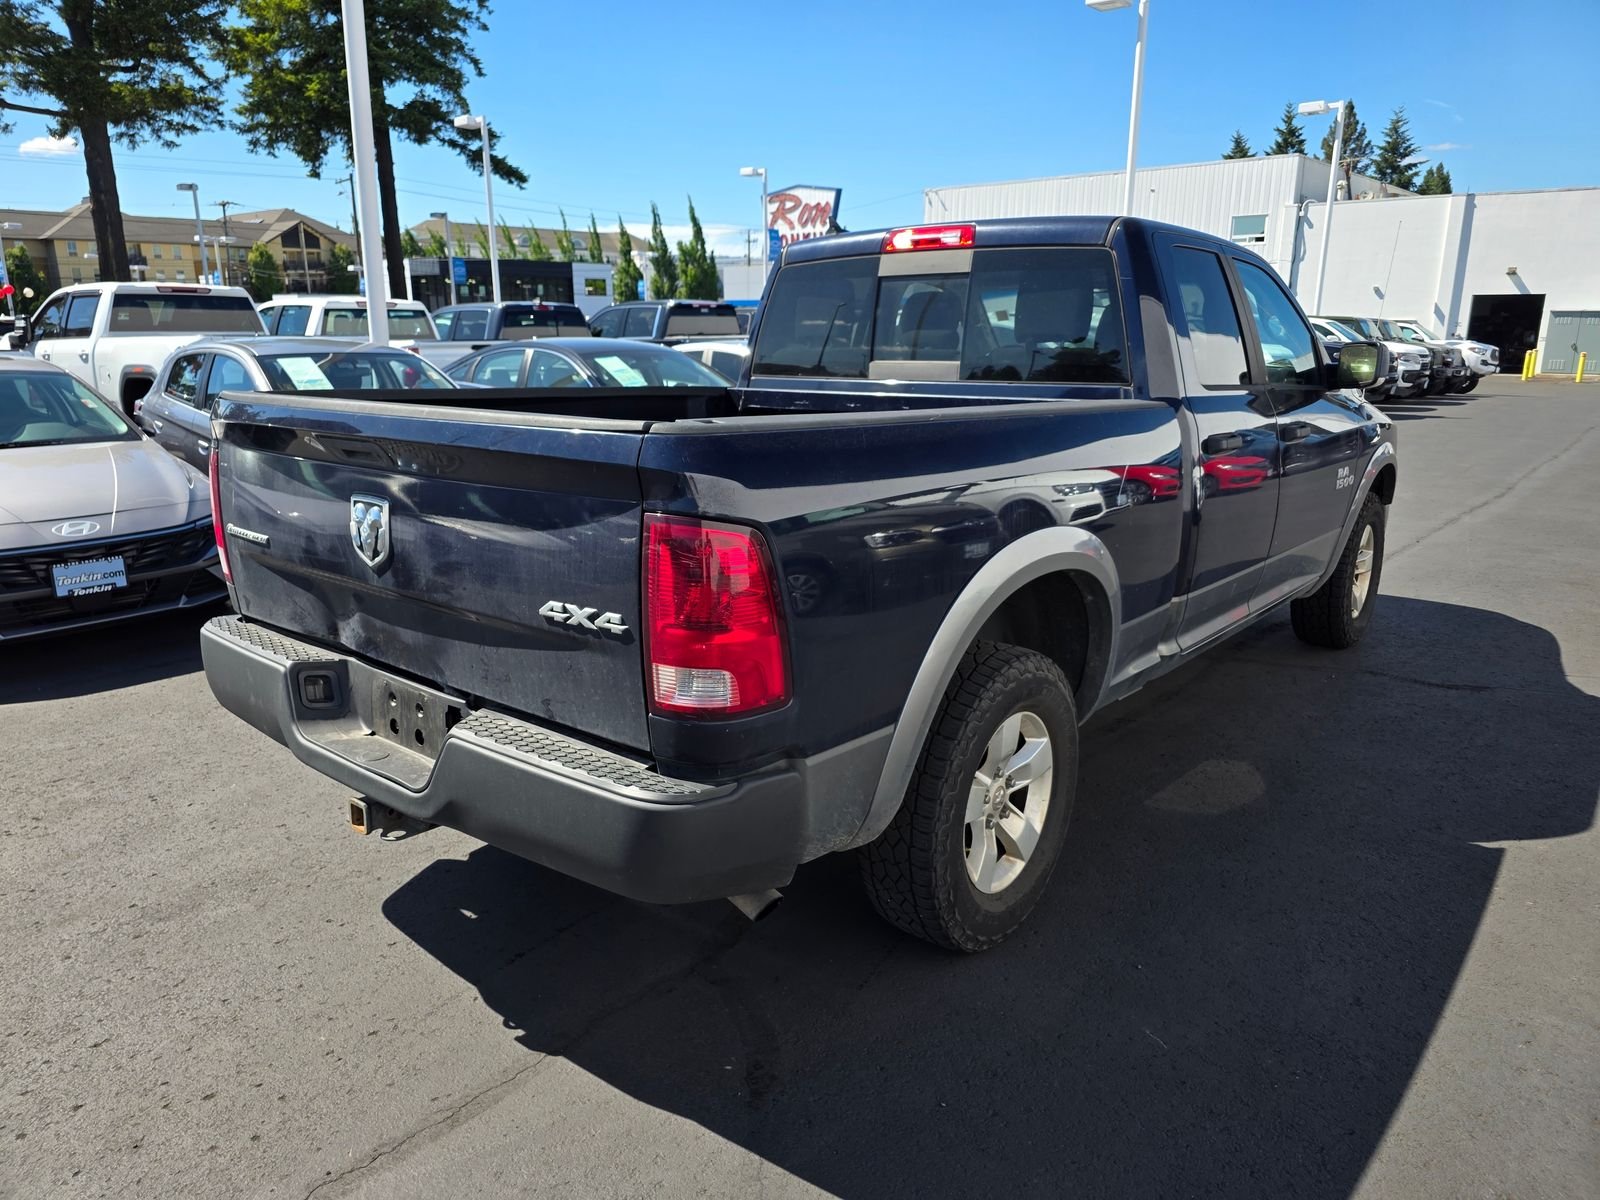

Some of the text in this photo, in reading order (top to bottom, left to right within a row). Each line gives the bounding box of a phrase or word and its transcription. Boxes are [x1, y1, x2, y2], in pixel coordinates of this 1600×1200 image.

[768, 193, 832, 230] Ron
[1336, 475, 1355, 490] 1500
[56, 569, 125, 587] Tonkin.com
[72, 583, 113, 597] Tonkin
